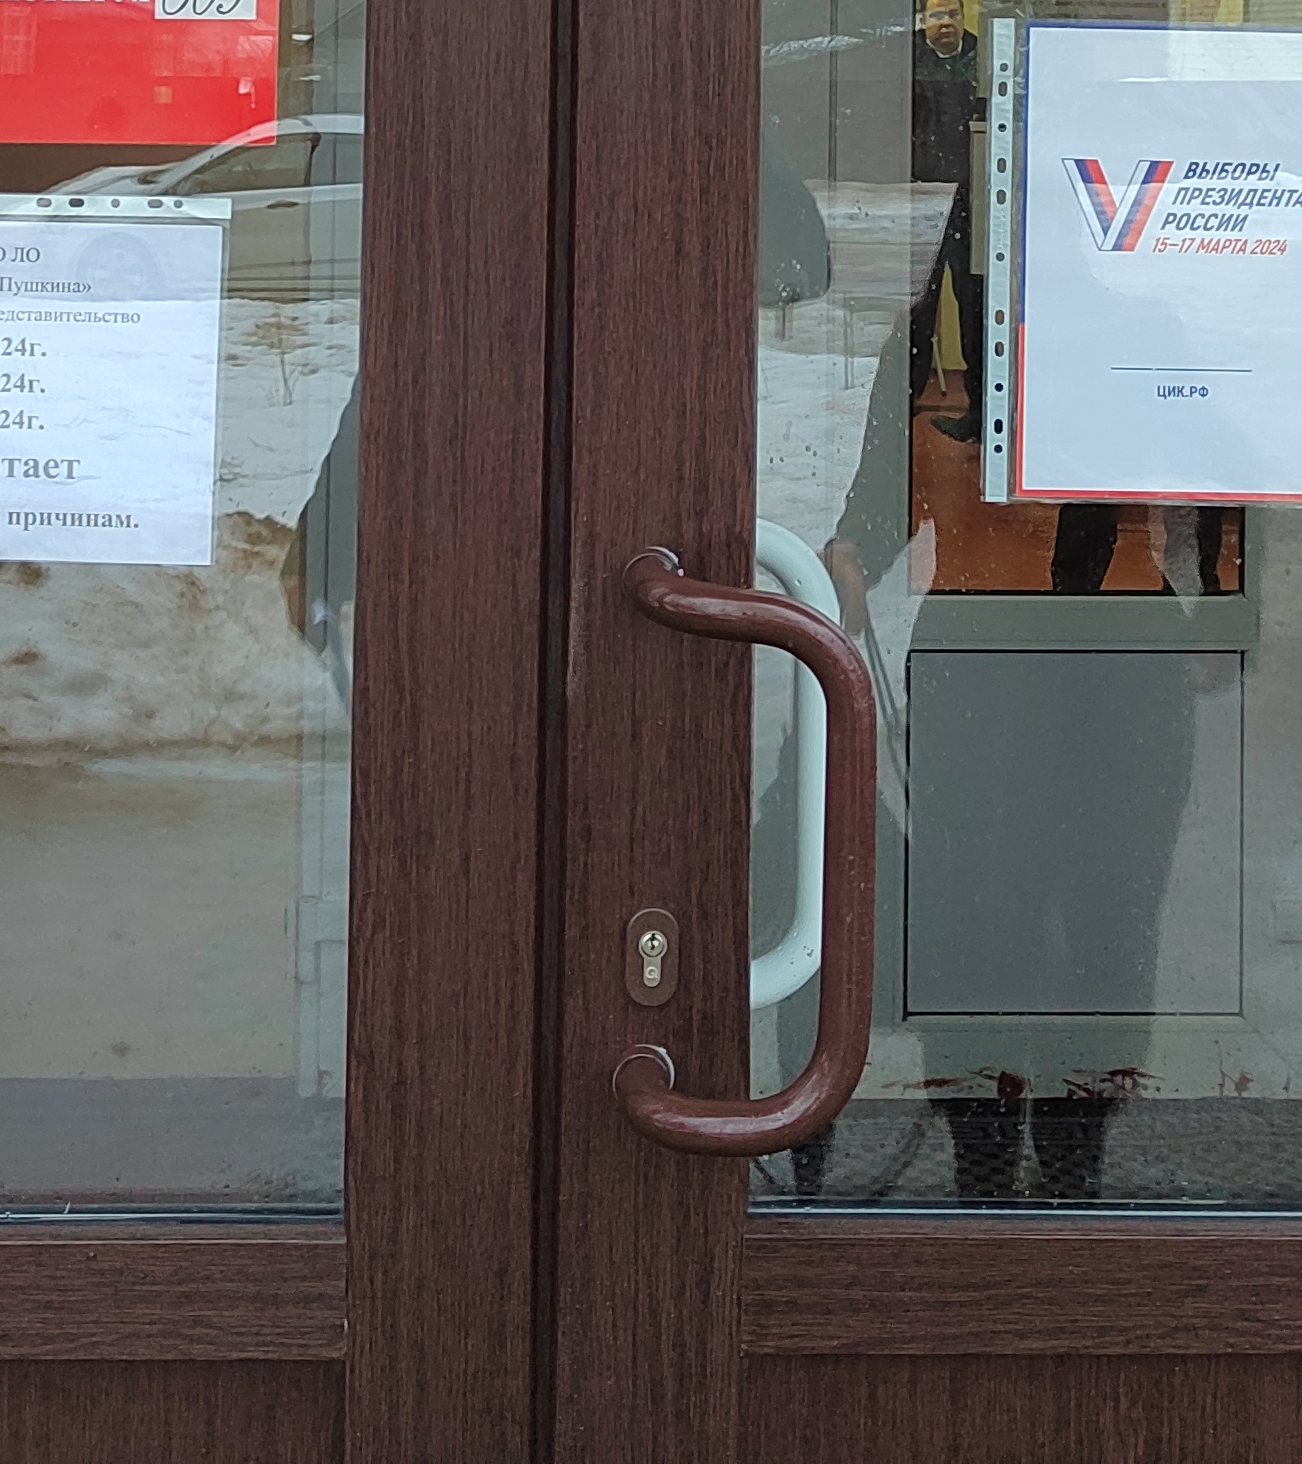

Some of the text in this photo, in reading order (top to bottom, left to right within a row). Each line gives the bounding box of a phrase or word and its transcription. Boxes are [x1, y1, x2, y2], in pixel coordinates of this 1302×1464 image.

[1183, 161, 1281, 182] ВЫБОРЫ
[1160, 212, 1249, 233] РОССИИ
[10, 247, 41, 265] ЛО
[1197, 238, 1249, 255] МАРТА
[1251, 239, 1287, 256] 2024
[0, 276, 92, 296] Пушкина»
[1157, 384, 1209, 400] ЦИК.РФ
[7, 510, 140, 531] причинам.
